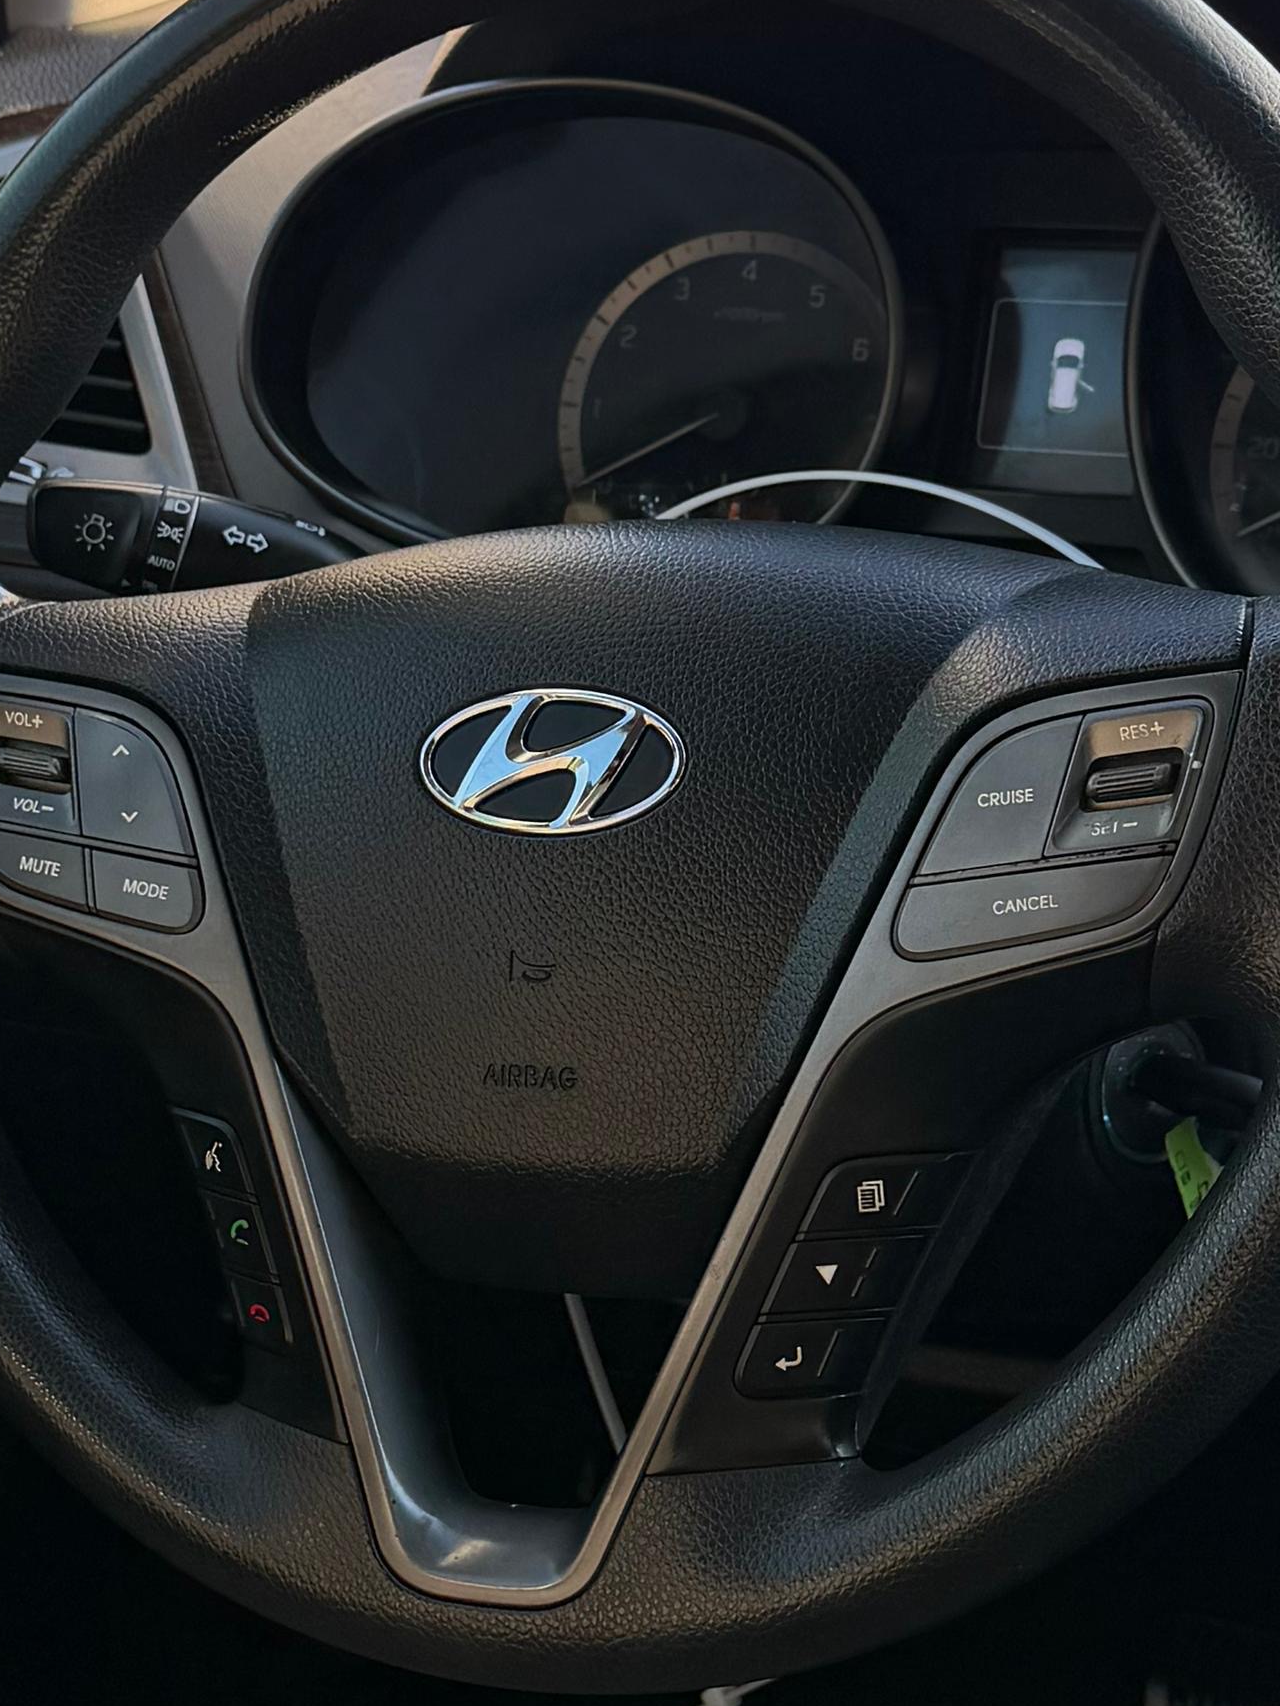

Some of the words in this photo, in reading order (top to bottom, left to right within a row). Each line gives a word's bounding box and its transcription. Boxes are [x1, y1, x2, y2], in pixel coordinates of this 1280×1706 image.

[742, 260, 757, 280] 4
[675, 278, 690, 300] 3
[809, 285, 825, 307] 5
[621, 325, 637, 347] 2
[853, 338, 869, 361] 6
[147, 554, 176, 572] AUTO
[1119, 720, 1165, 742] RES+
[977, 788, 1034, 808] CRUISE
[19, 856, 61, 877] MUTE
[122, 878, 169, 900] MODE
[992, 894, 1059, 915] CANCEL
[483, 1063, 577, 1090] AIRBAG
